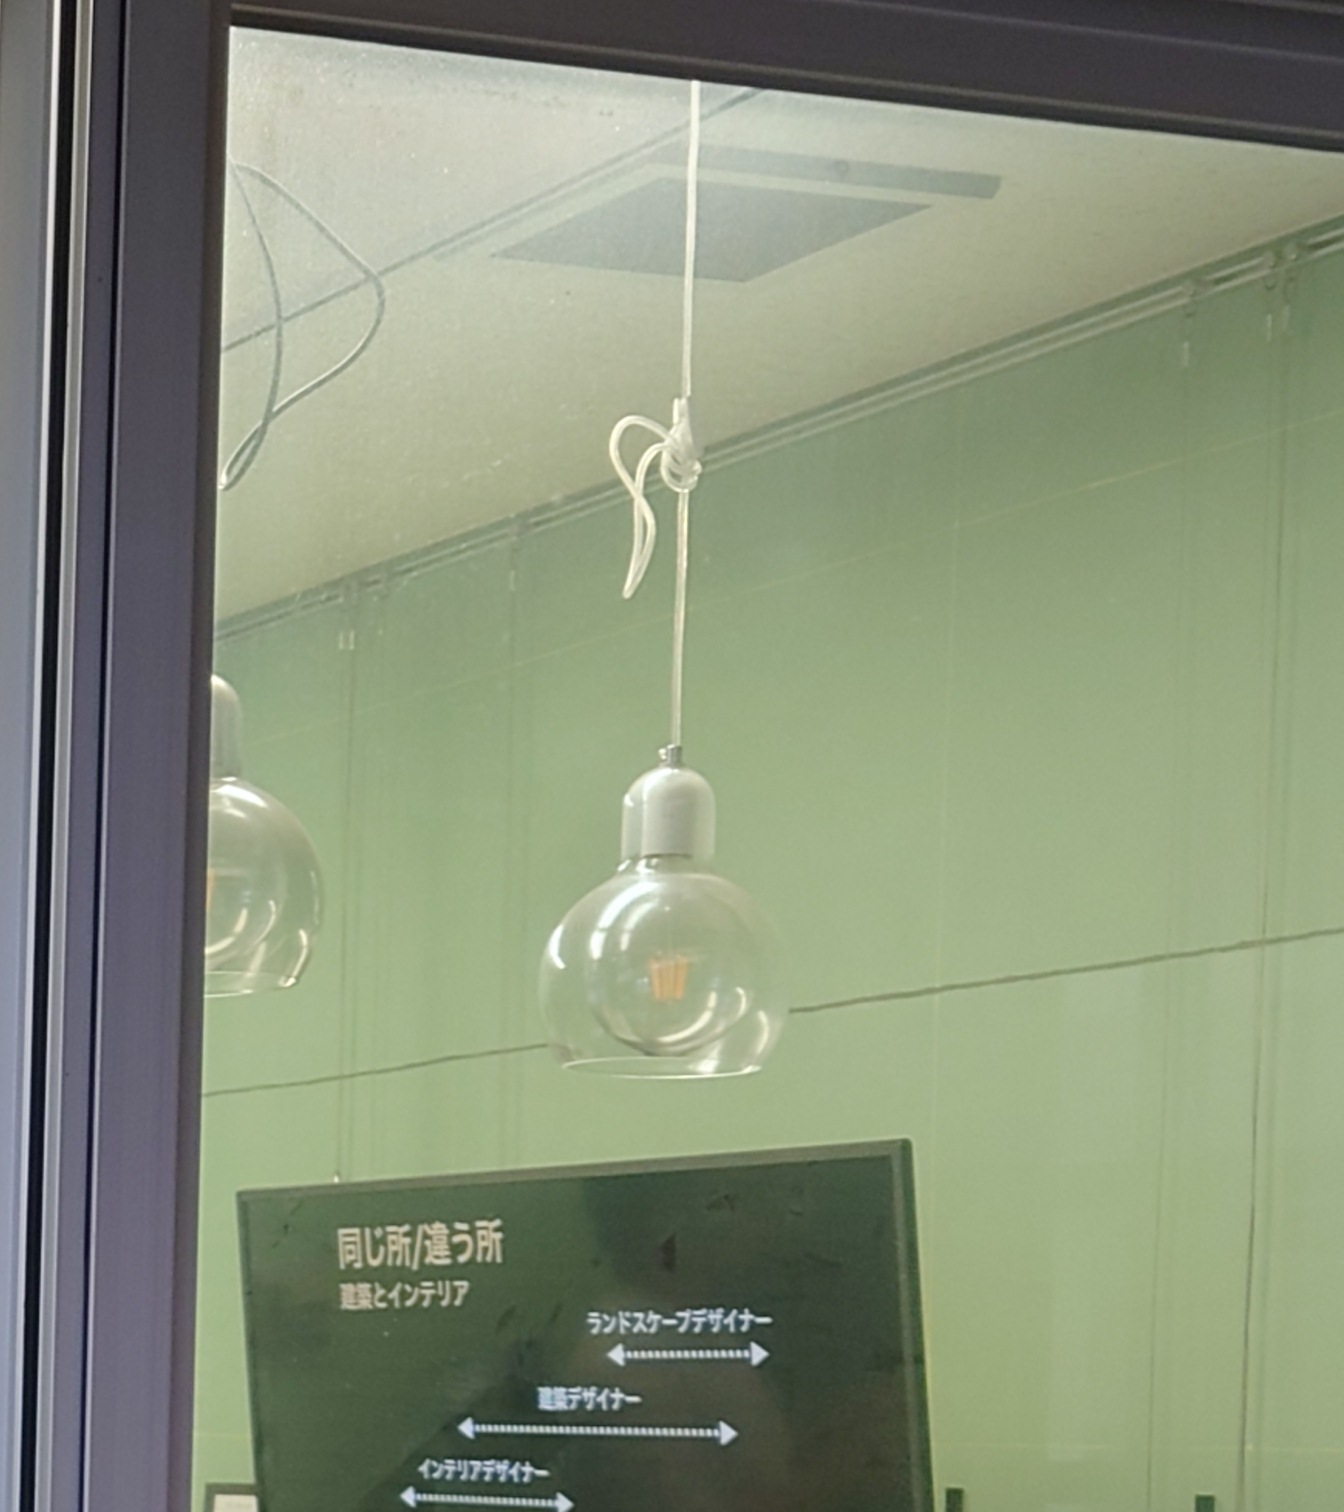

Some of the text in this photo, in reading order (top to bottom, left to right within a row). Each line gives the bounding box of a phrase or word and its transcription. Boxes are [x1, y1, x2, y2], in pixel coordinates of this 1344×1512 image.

[336, 1219, 504, 1271] 同じ所/違う所
[338, 1280, 470, 1310] 建築とインテリア
[586, 1307, 773, 1334] ランドスケープデザイナー
[417, 1458, 550, 1483] インテリアデザイナー
